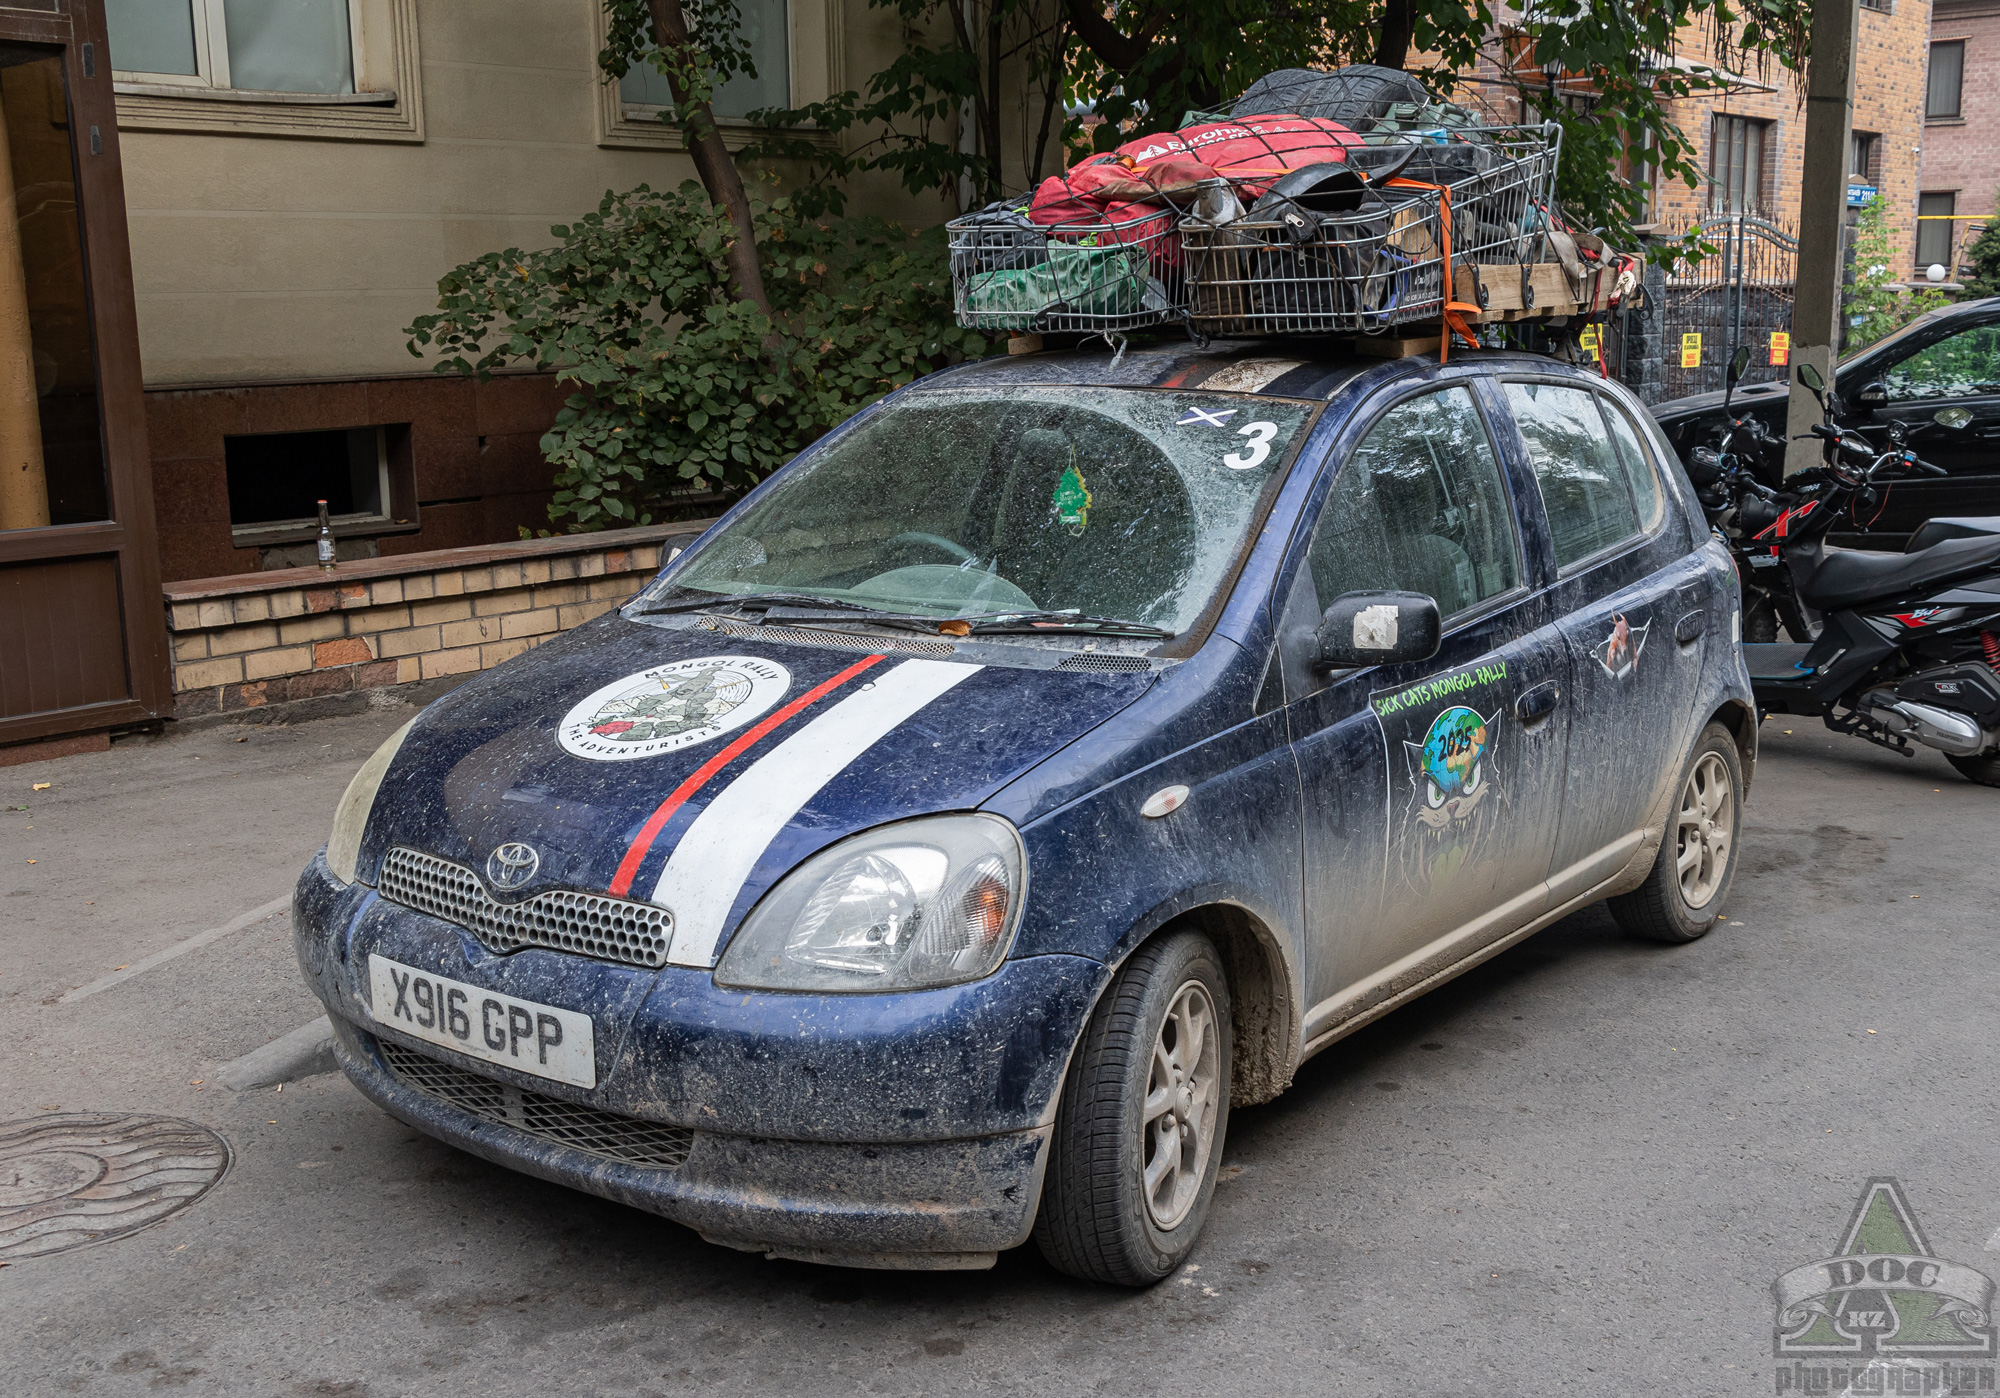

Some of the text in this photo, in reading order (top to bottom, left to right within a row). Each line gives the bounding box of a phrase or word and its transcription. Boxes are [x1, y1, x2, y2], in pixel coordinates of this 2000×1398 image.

[1223, 421, 1278, 470] 3
[644, 659, 778, 681] MONGOL RALLY
[1376, 661, 1508, 718] SICK CATS MONGOL RALLY
[567, 722, 722, 755] THE ADVENTURISTS
[1437, 725, 1473, 762] 2025
[389, 967, 564, 1065] X916 GPP
